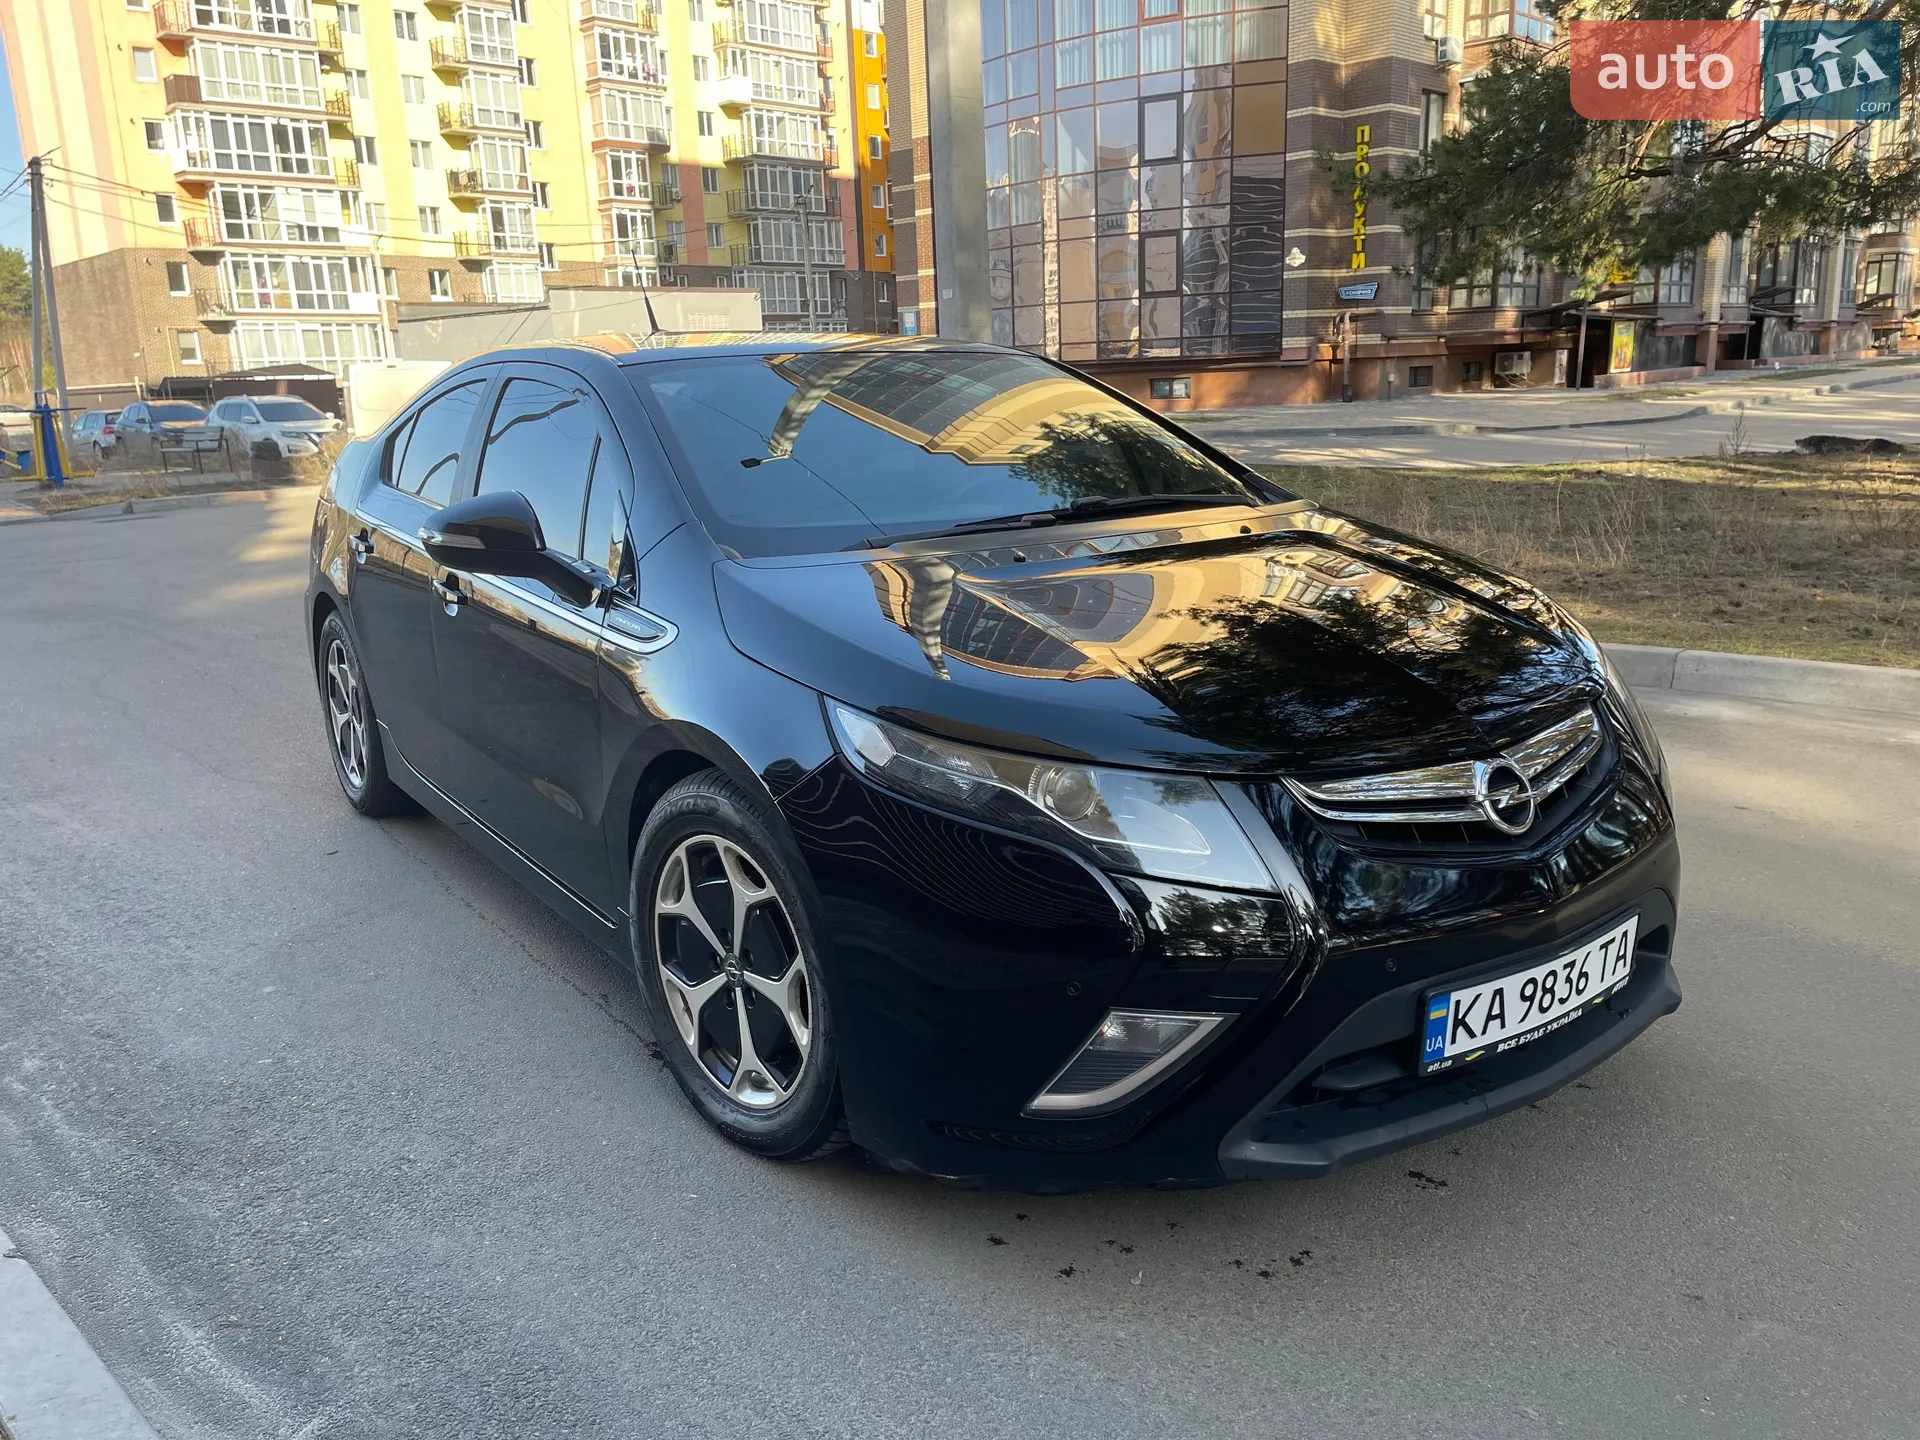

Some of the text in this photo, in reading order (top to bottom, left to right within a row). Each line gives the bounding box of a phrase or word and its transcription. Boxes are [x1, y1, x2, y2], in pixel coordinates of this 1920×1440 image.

[1450, 928, 1629, 1045] KA 9836 TA
[1426, 1035, 1444, 1053] UA
